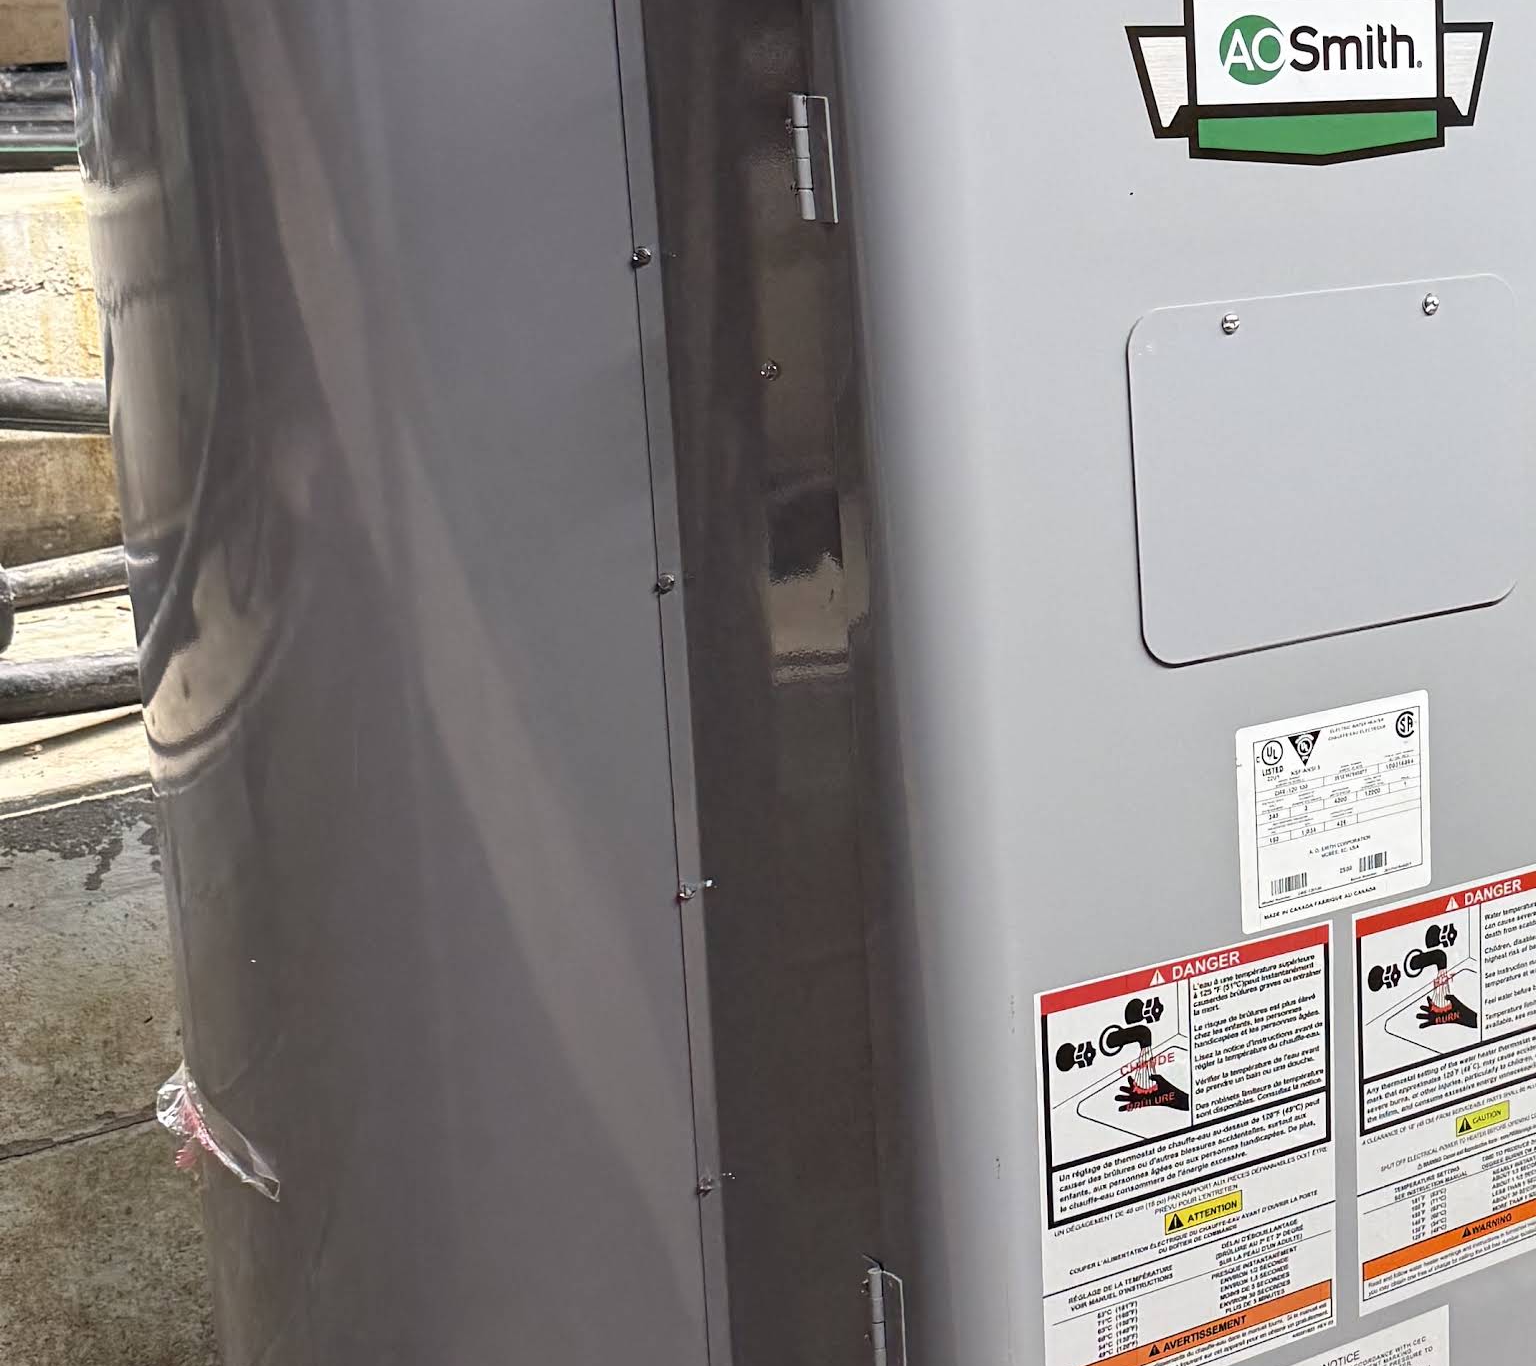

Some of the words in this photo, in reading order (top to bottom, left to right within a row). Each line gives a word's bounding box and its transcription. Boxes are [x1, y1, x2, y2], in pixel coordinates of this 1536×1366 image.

[1222, 28, 1286, 73] AO
[1264, 746, 1278, 762] UL
[1262, 765, 1283, 776] LISTED
[1464, 878, 1521, 905] DANGER
[1172, 950, 1239, 980] DANGER
[1472, 1109, 1501, 1124] CAUTION
[1059, 1179, 1085, 1192] causer
[1103, 1164, 1135, 1178] brûlures
[1187, 1199, 1237, 1223] ATTENTION
[1471, 1212, 1511, 1234] WARNING
[1162, 1314, 1246, 1352] AVERTISSEMENT
